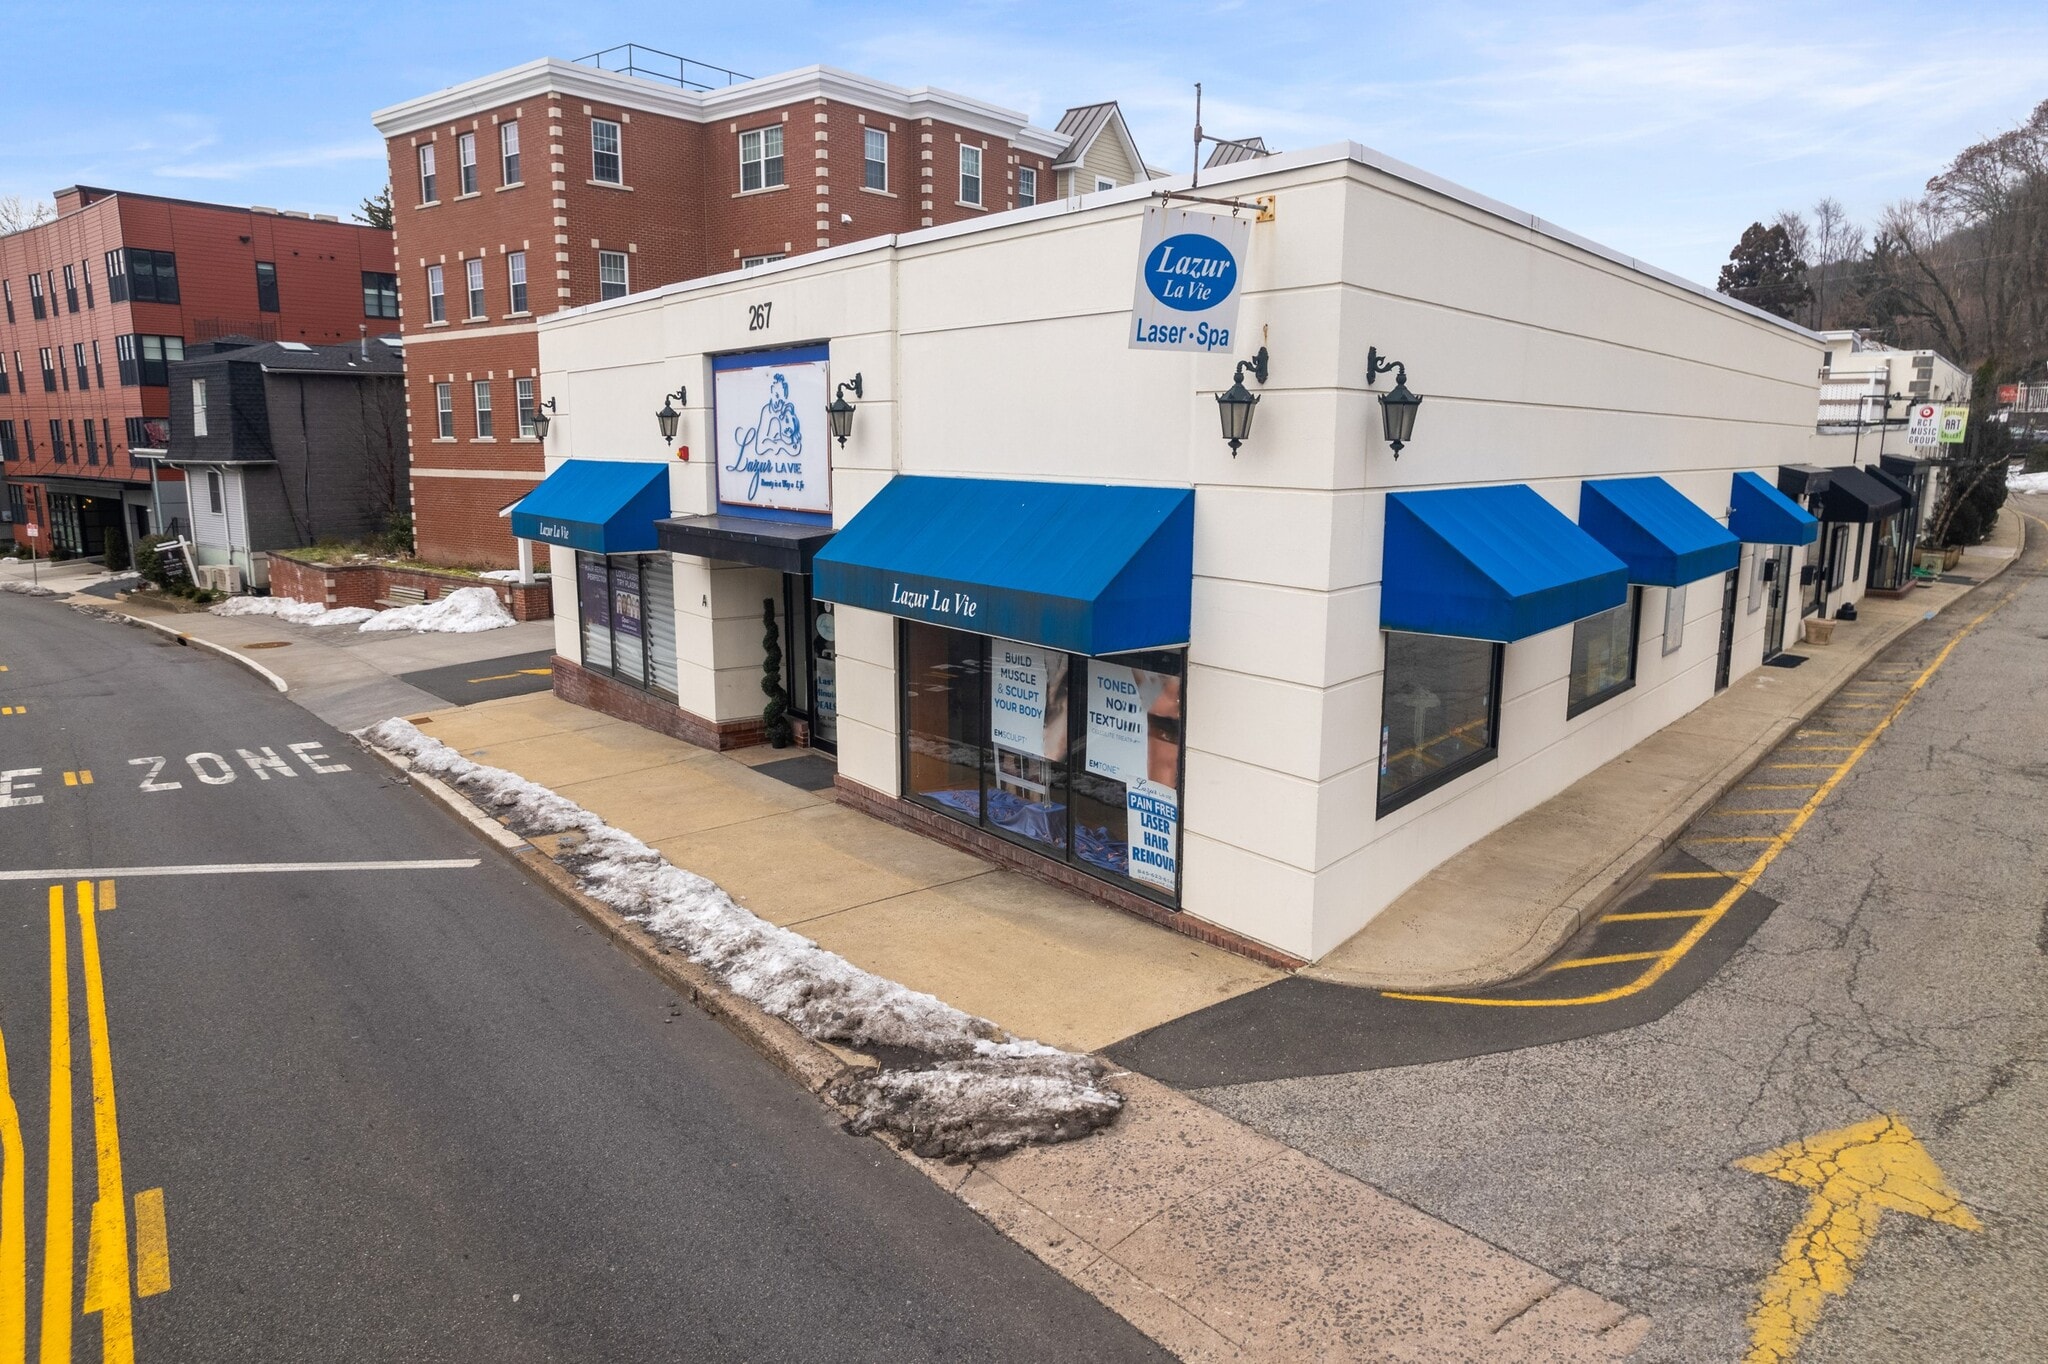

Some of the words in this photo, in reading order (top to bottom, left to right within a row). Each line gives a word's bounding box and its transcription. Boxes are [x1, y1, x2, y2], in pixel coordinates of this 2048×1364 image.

[1156, 245, 1230, 279] Lazur
[1162, 279, 1184, 299] La
[1187, 281, 1212, 301] Vie
[748, 301, 773, 331] 267
[1136, 318, 1187, 344] Laser
[1196, 321, 1230, 351] Spa
[1910, 427, 1937, 436] MUSIC
[1917, 418, 1933, 427] RCT
[1944, 418, 1962, 430] ART
[1908, 435, 1936, 445] GROUP
[726, 427, 773, 501] Lazur
[775, 462, 787, 473] LA
[787, 462, 802, 474] VIE
[701, 594, 708, 608] A
[891, 582, 930, 609] Lazur
[931, 589, 951, 613] La
[954, 592, 977, 618] Vie
[1005, 652, 1033, 668] BUILD
[1000, 667, 1037, 686] MUSCLE
[1097, 676, 1137, 695] TONED
[997, 683, 1004, 694] &
[1005, 685, 1040, 703] SCULPT
[994, 698, 1018, 713] YOUR
[1018, 704, 1043, 719] BODY
[993, 728, 1027, 744] EMSCULPT
[128, 741, 352, 793] ZONE
[1088, 759, 1117, 775] EMTONE
[1130, 794, 1153, 812] PAIN
[1154, 801, 1176, 820] FREE
[1140, 812, 1171, 836] LASER
[1143, 831, 1169, 853] HAIR
[1132, 846, 1175, 873] REMOVA
